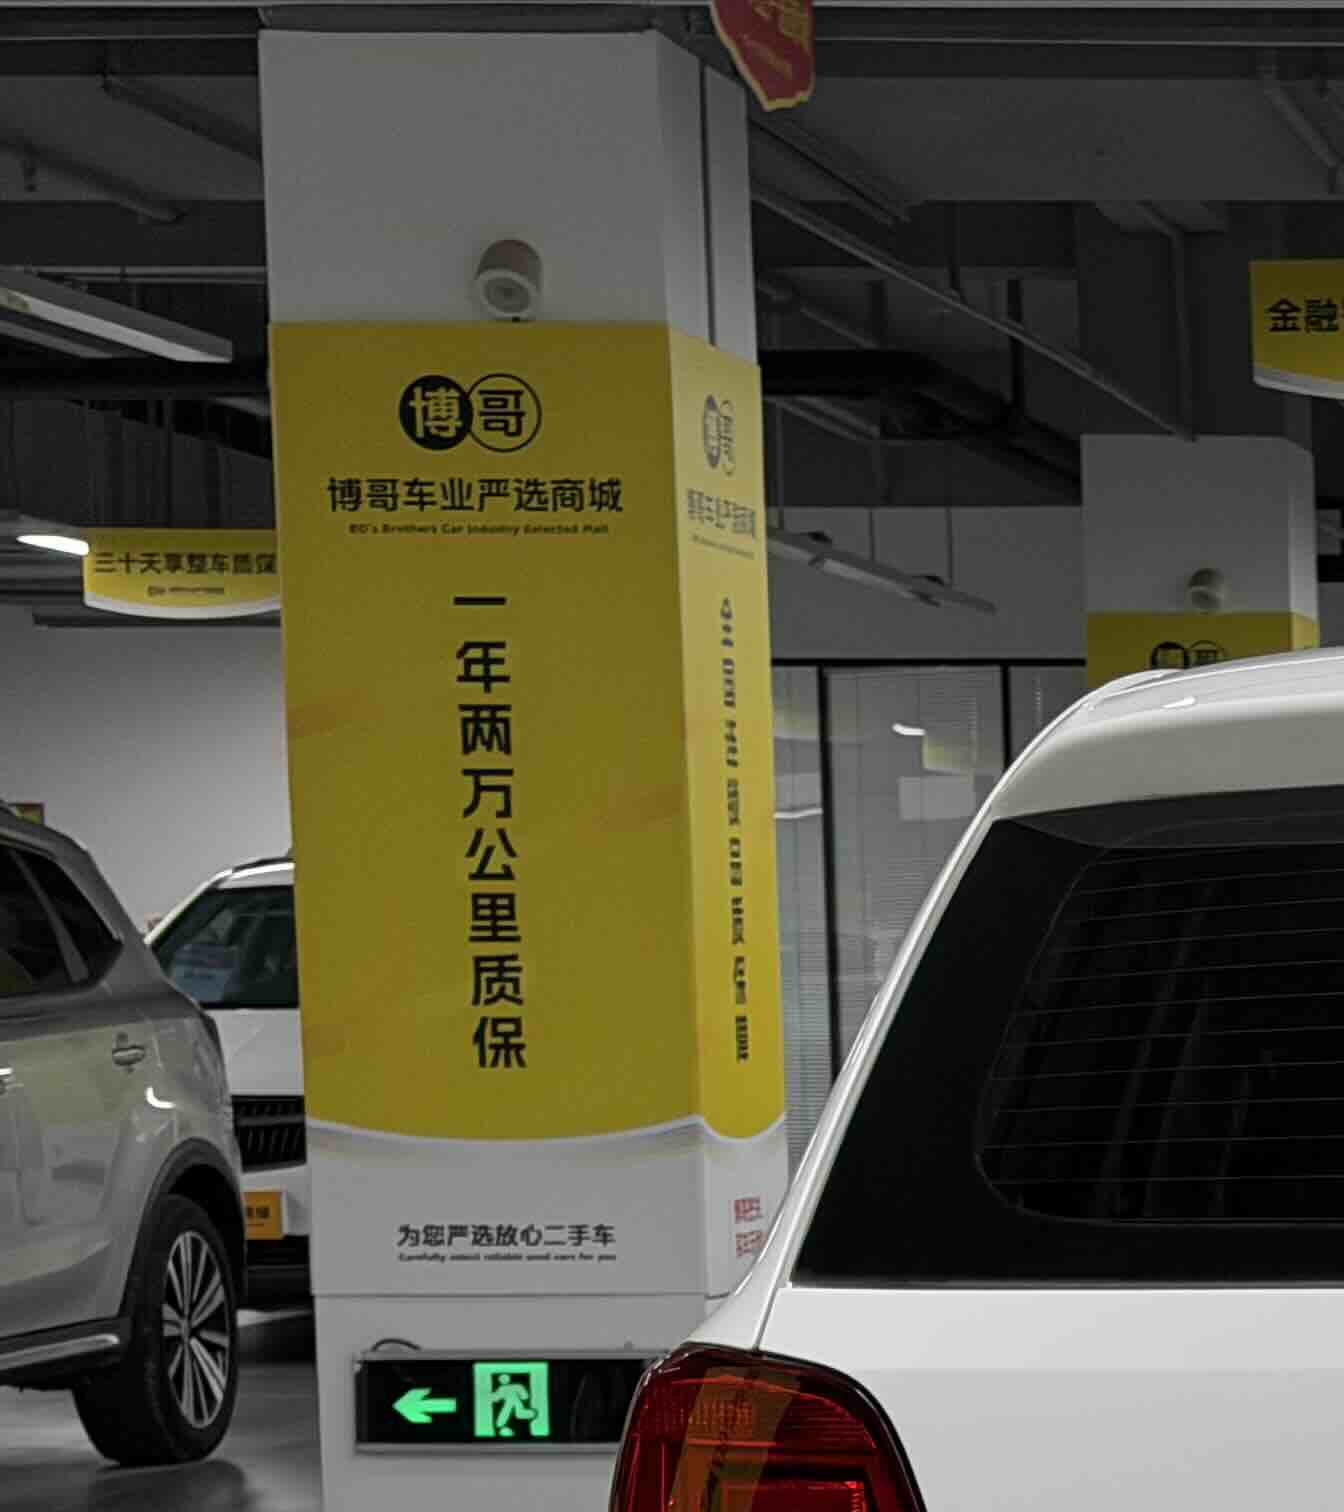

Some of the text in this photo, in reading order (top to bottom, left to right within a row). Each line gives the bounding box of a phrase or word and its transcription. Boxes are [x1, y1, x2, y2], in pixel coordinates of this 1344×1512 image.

[404, 380, 534, 446] 博哥
[328, 478, 624, 513] 博哥车业严选商城
[453, 596, 527, 1069] 一年两万公里质保
[397, 1224, 616, 1247] 为您严选放心二手车
